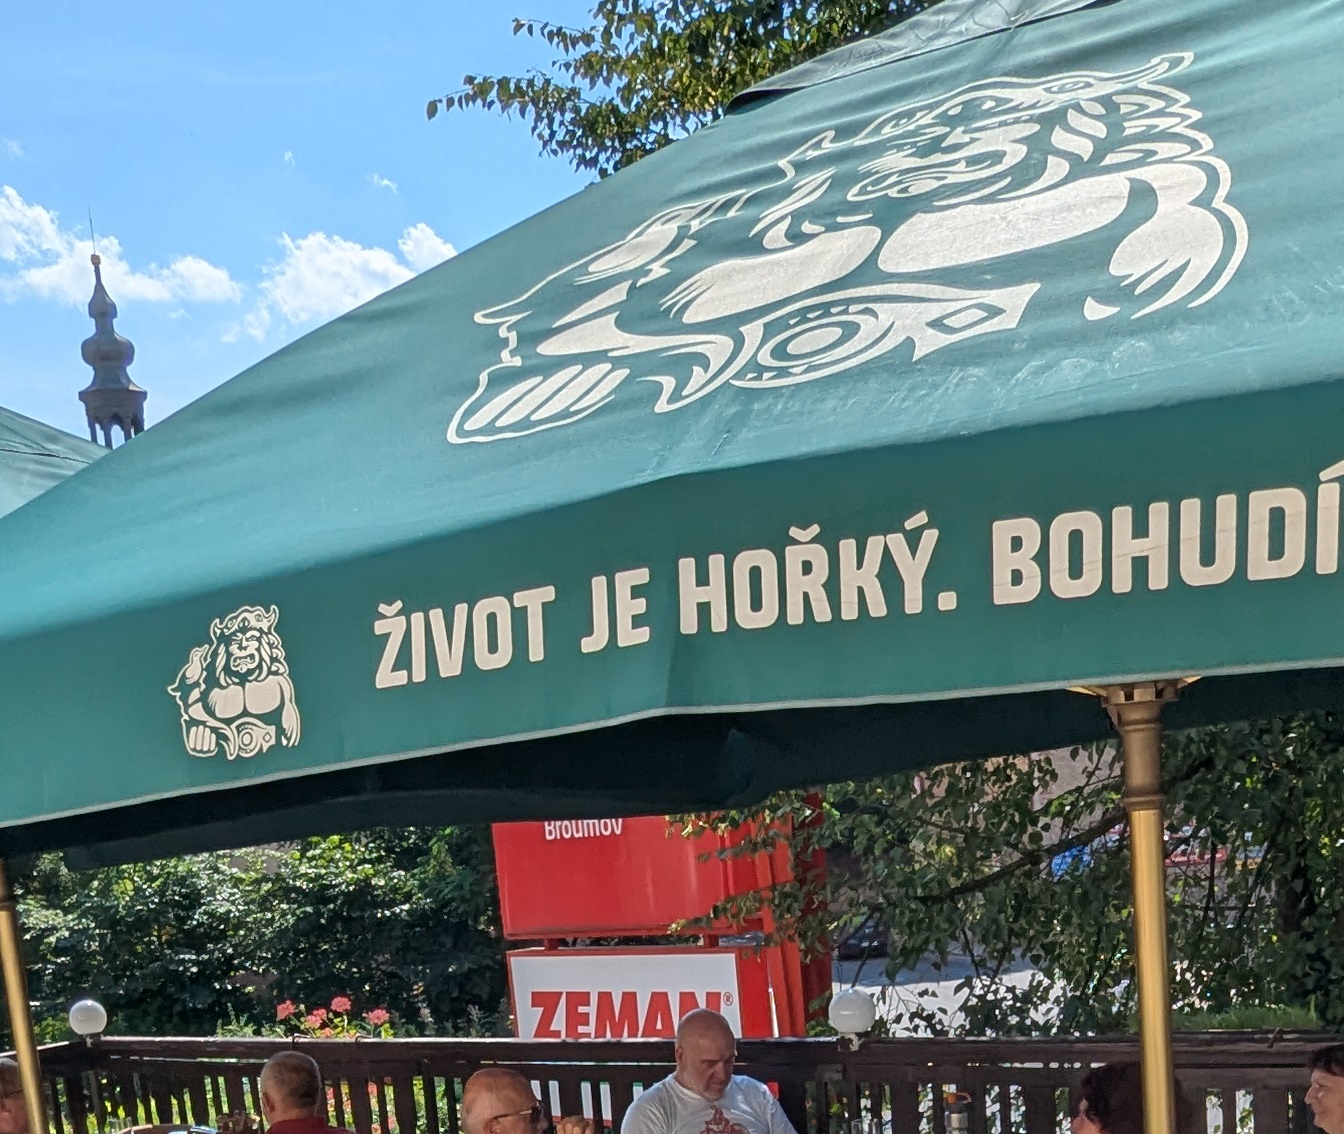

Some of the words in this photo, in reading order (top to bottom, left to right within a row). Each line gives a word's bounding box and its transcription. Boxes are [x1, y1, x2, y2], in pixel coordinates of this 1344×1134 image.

[373, 586, 556, 689] ŽIVOT
[580, 567, 651, 654] JE
[678, 510, 958, 635] HOŘKÝ.
[544, 818, 623, 841] Broumov
